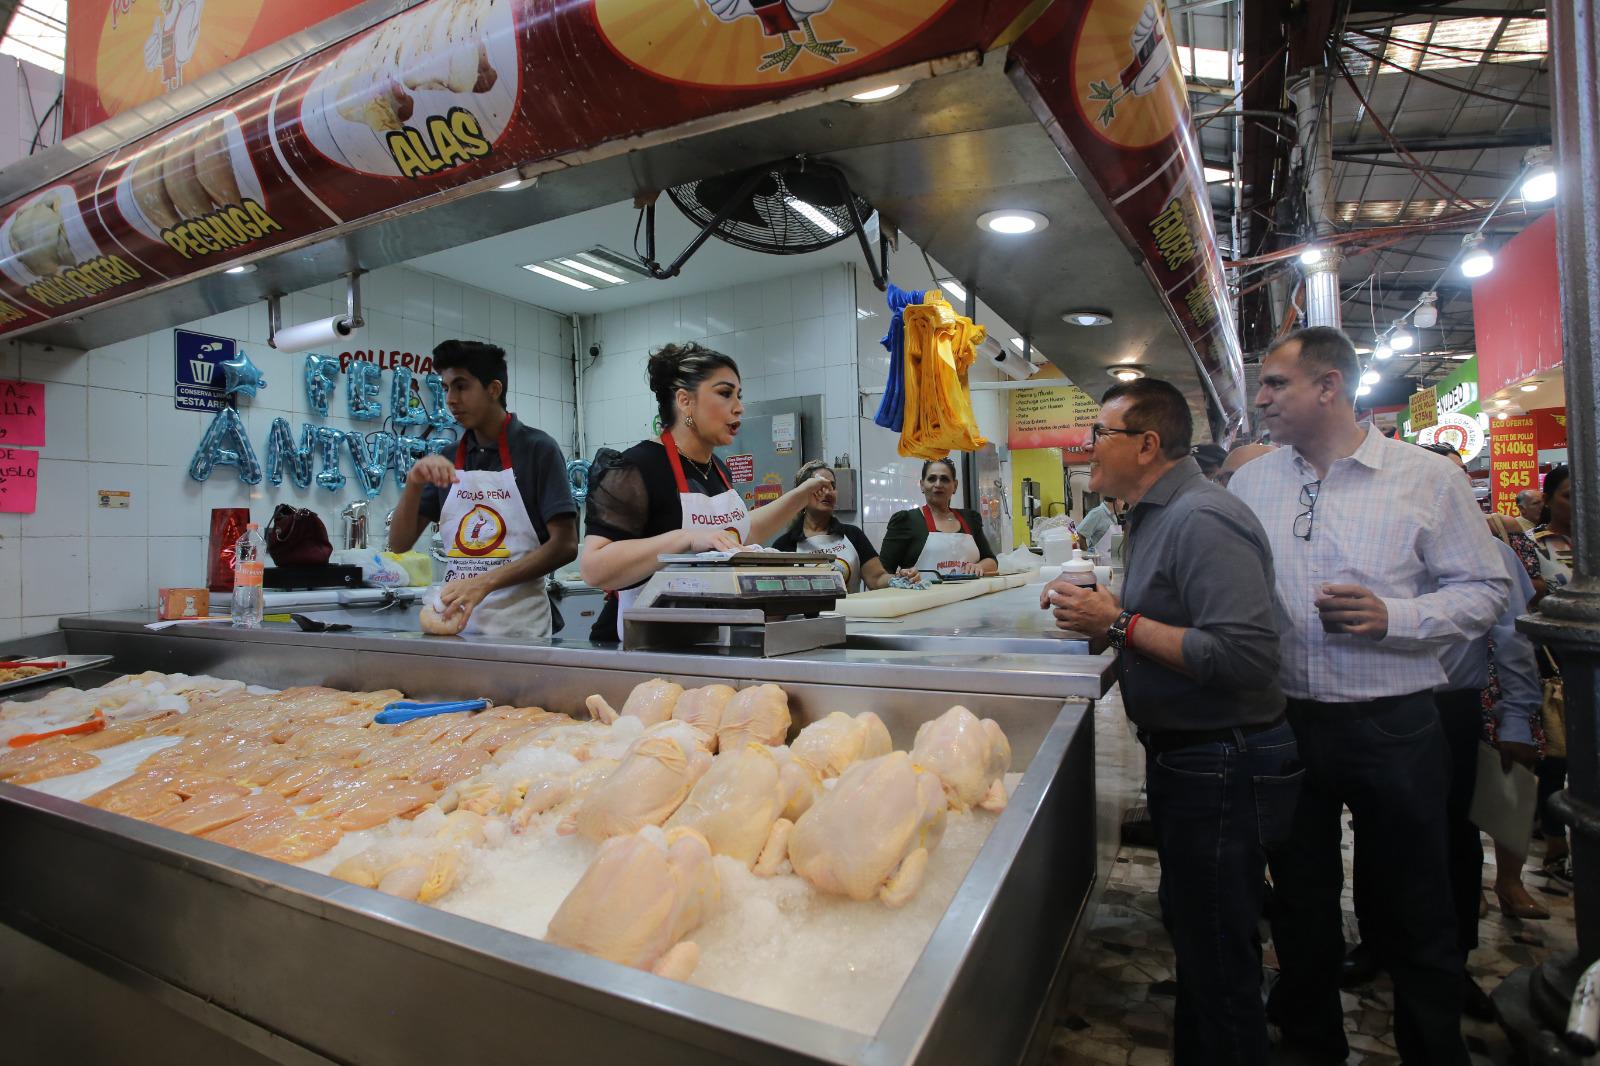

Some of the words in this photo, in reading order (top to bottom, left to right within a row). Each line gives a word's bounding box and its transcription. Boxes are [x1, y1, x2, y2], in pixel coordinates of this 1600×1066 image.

[386, 106, 492, 178] ALAS
[161, 198, 282, 259] PECHUGA
[1149, 198, 1195, 271] TENDERS
[70, 254, 142, 297] ENTERO
[339, 350, 433, 374] POLLERIA
[180, 388, 212, 397] CONSERVA
[182, 397, 205, 407] ESTA
[1492, 419, 1505, 428] ECO
[1505, 418, 1534, 427] OFERTAS
[1492, 433, 1509, 442] FILETE
[1509, 433, 1517, 441] DE
[1517, 432, 1534, 440] POLLO
[1493, 441, 1534, 456] $140kg
[1511, 460, 1518, 470] DE
[1518, 460, 1535, 469] POLLO
[0, 466, 35, 478] USLO
[1499, 470, 1530, 488] $45
[487, 488, 511, 500] PEÑA
[1498, 491, 1508, 500] Ala
[1509, 491, 1517, 500] de
